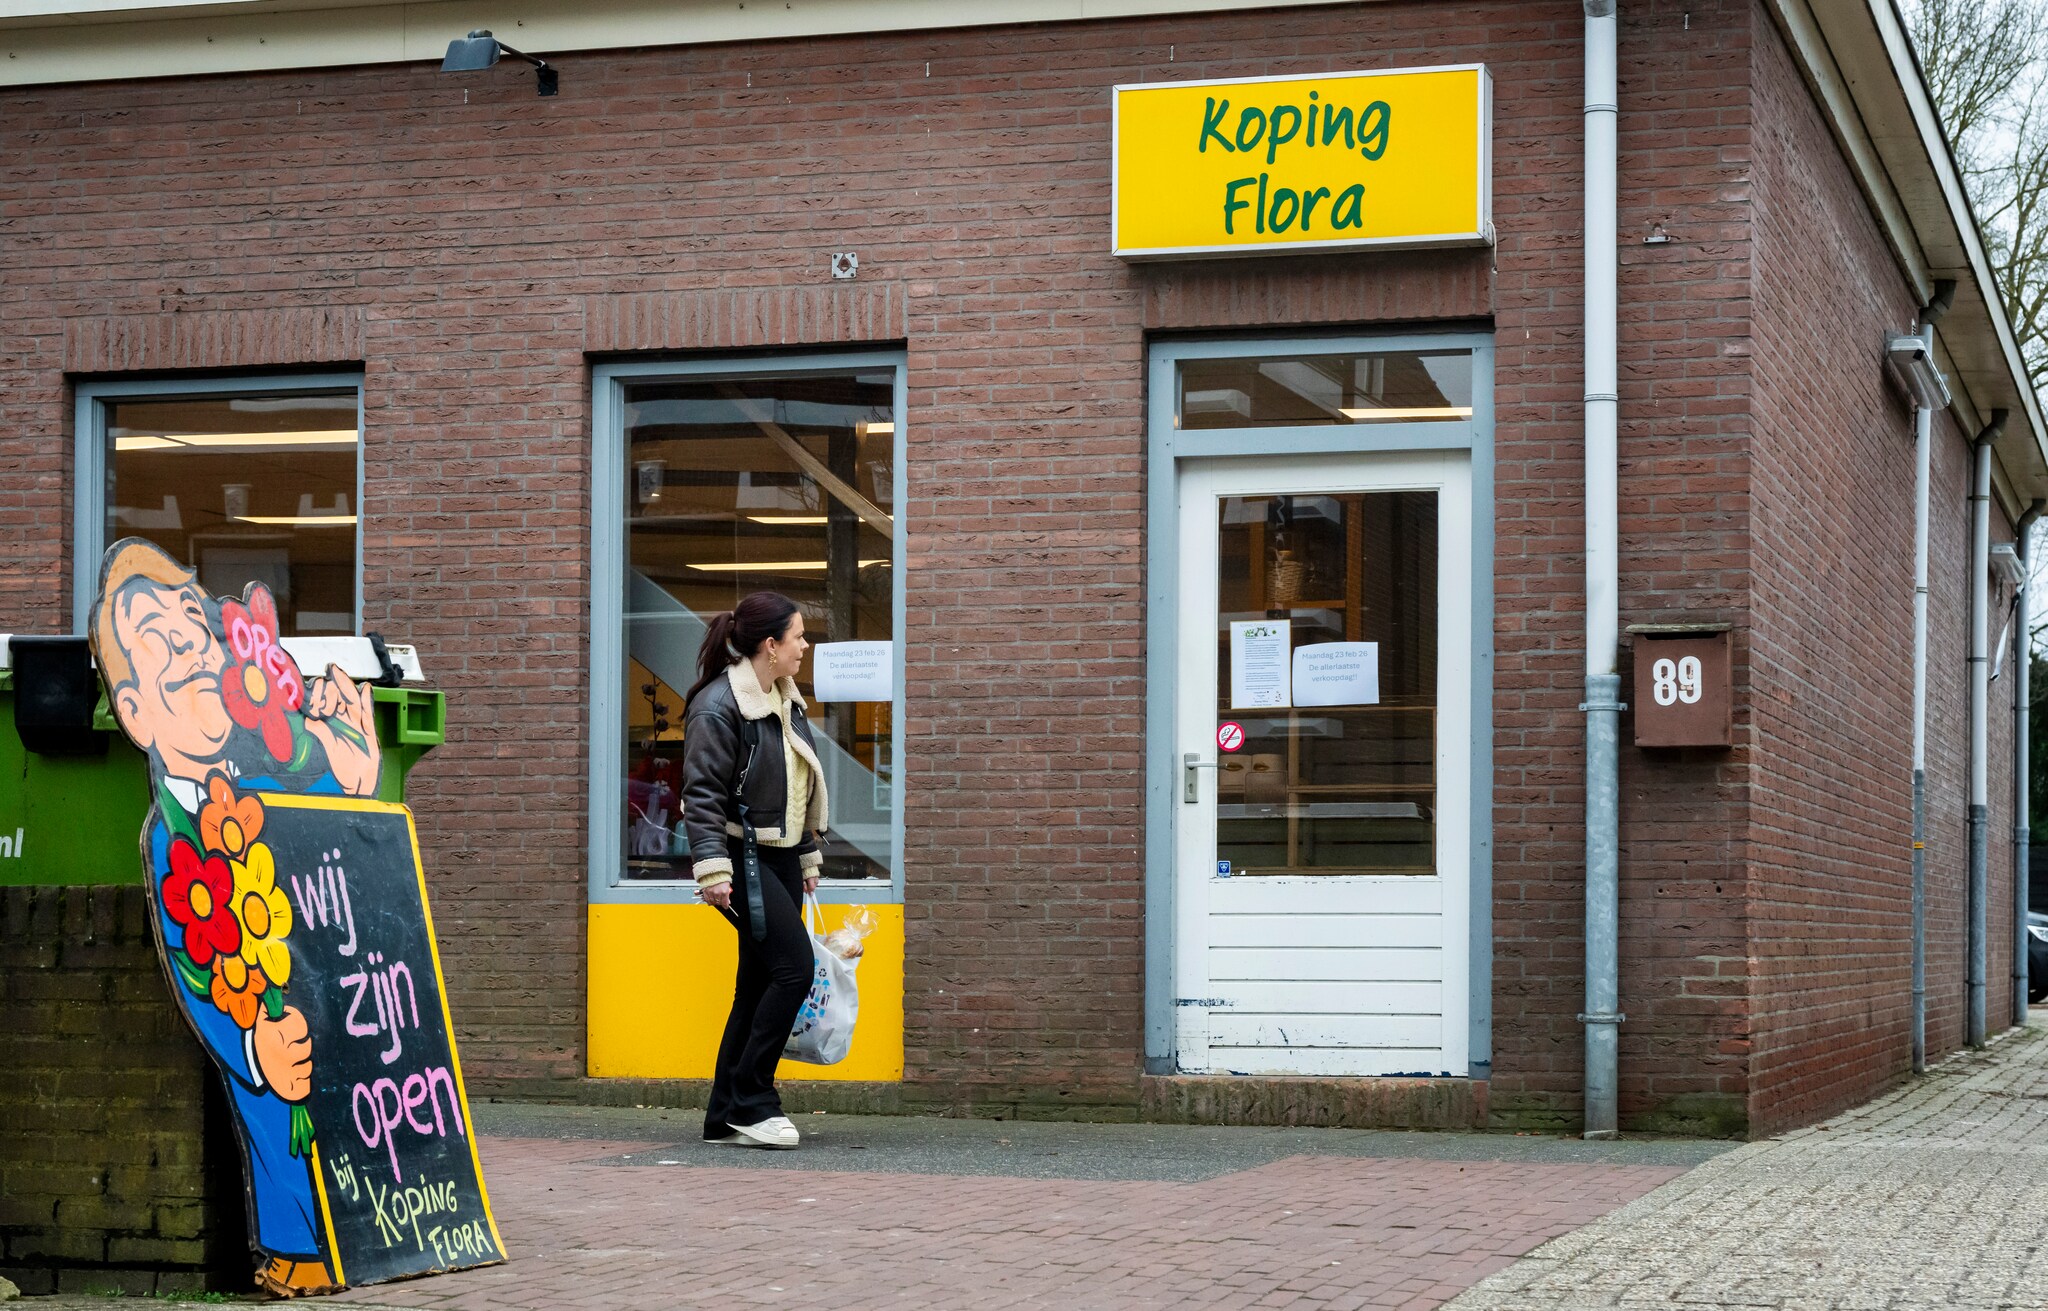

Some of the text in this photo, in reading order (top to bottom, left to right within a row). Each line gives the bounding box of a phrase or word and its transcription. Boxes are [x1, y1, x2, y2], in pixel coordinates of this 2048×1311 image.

[1199, 91, 1391, 165] Koping
[1224, 173, 1366, 235] Flora
[823, 650, 854, 659] Maandag
[854, 649, 864, 657] 23
[864, 649, 876, 657] feb
[840, 661, 879, 669] allerlaatste
[1301, 651, 1334, 660] Maandag
[1311, 673, 1358, 682] verkoopdag!!
[1320, 663, 1361, 671] allerlaatste
[1653, 656, 1702, 706] 89
[292, 848, 357, 956] wij
[340, 952, 420, 1065] zijn
[353, 1066, 464, 1184] open
[329, 1153, 360, 1202] bij
[427, 1220, 494, 1268] FLORA
